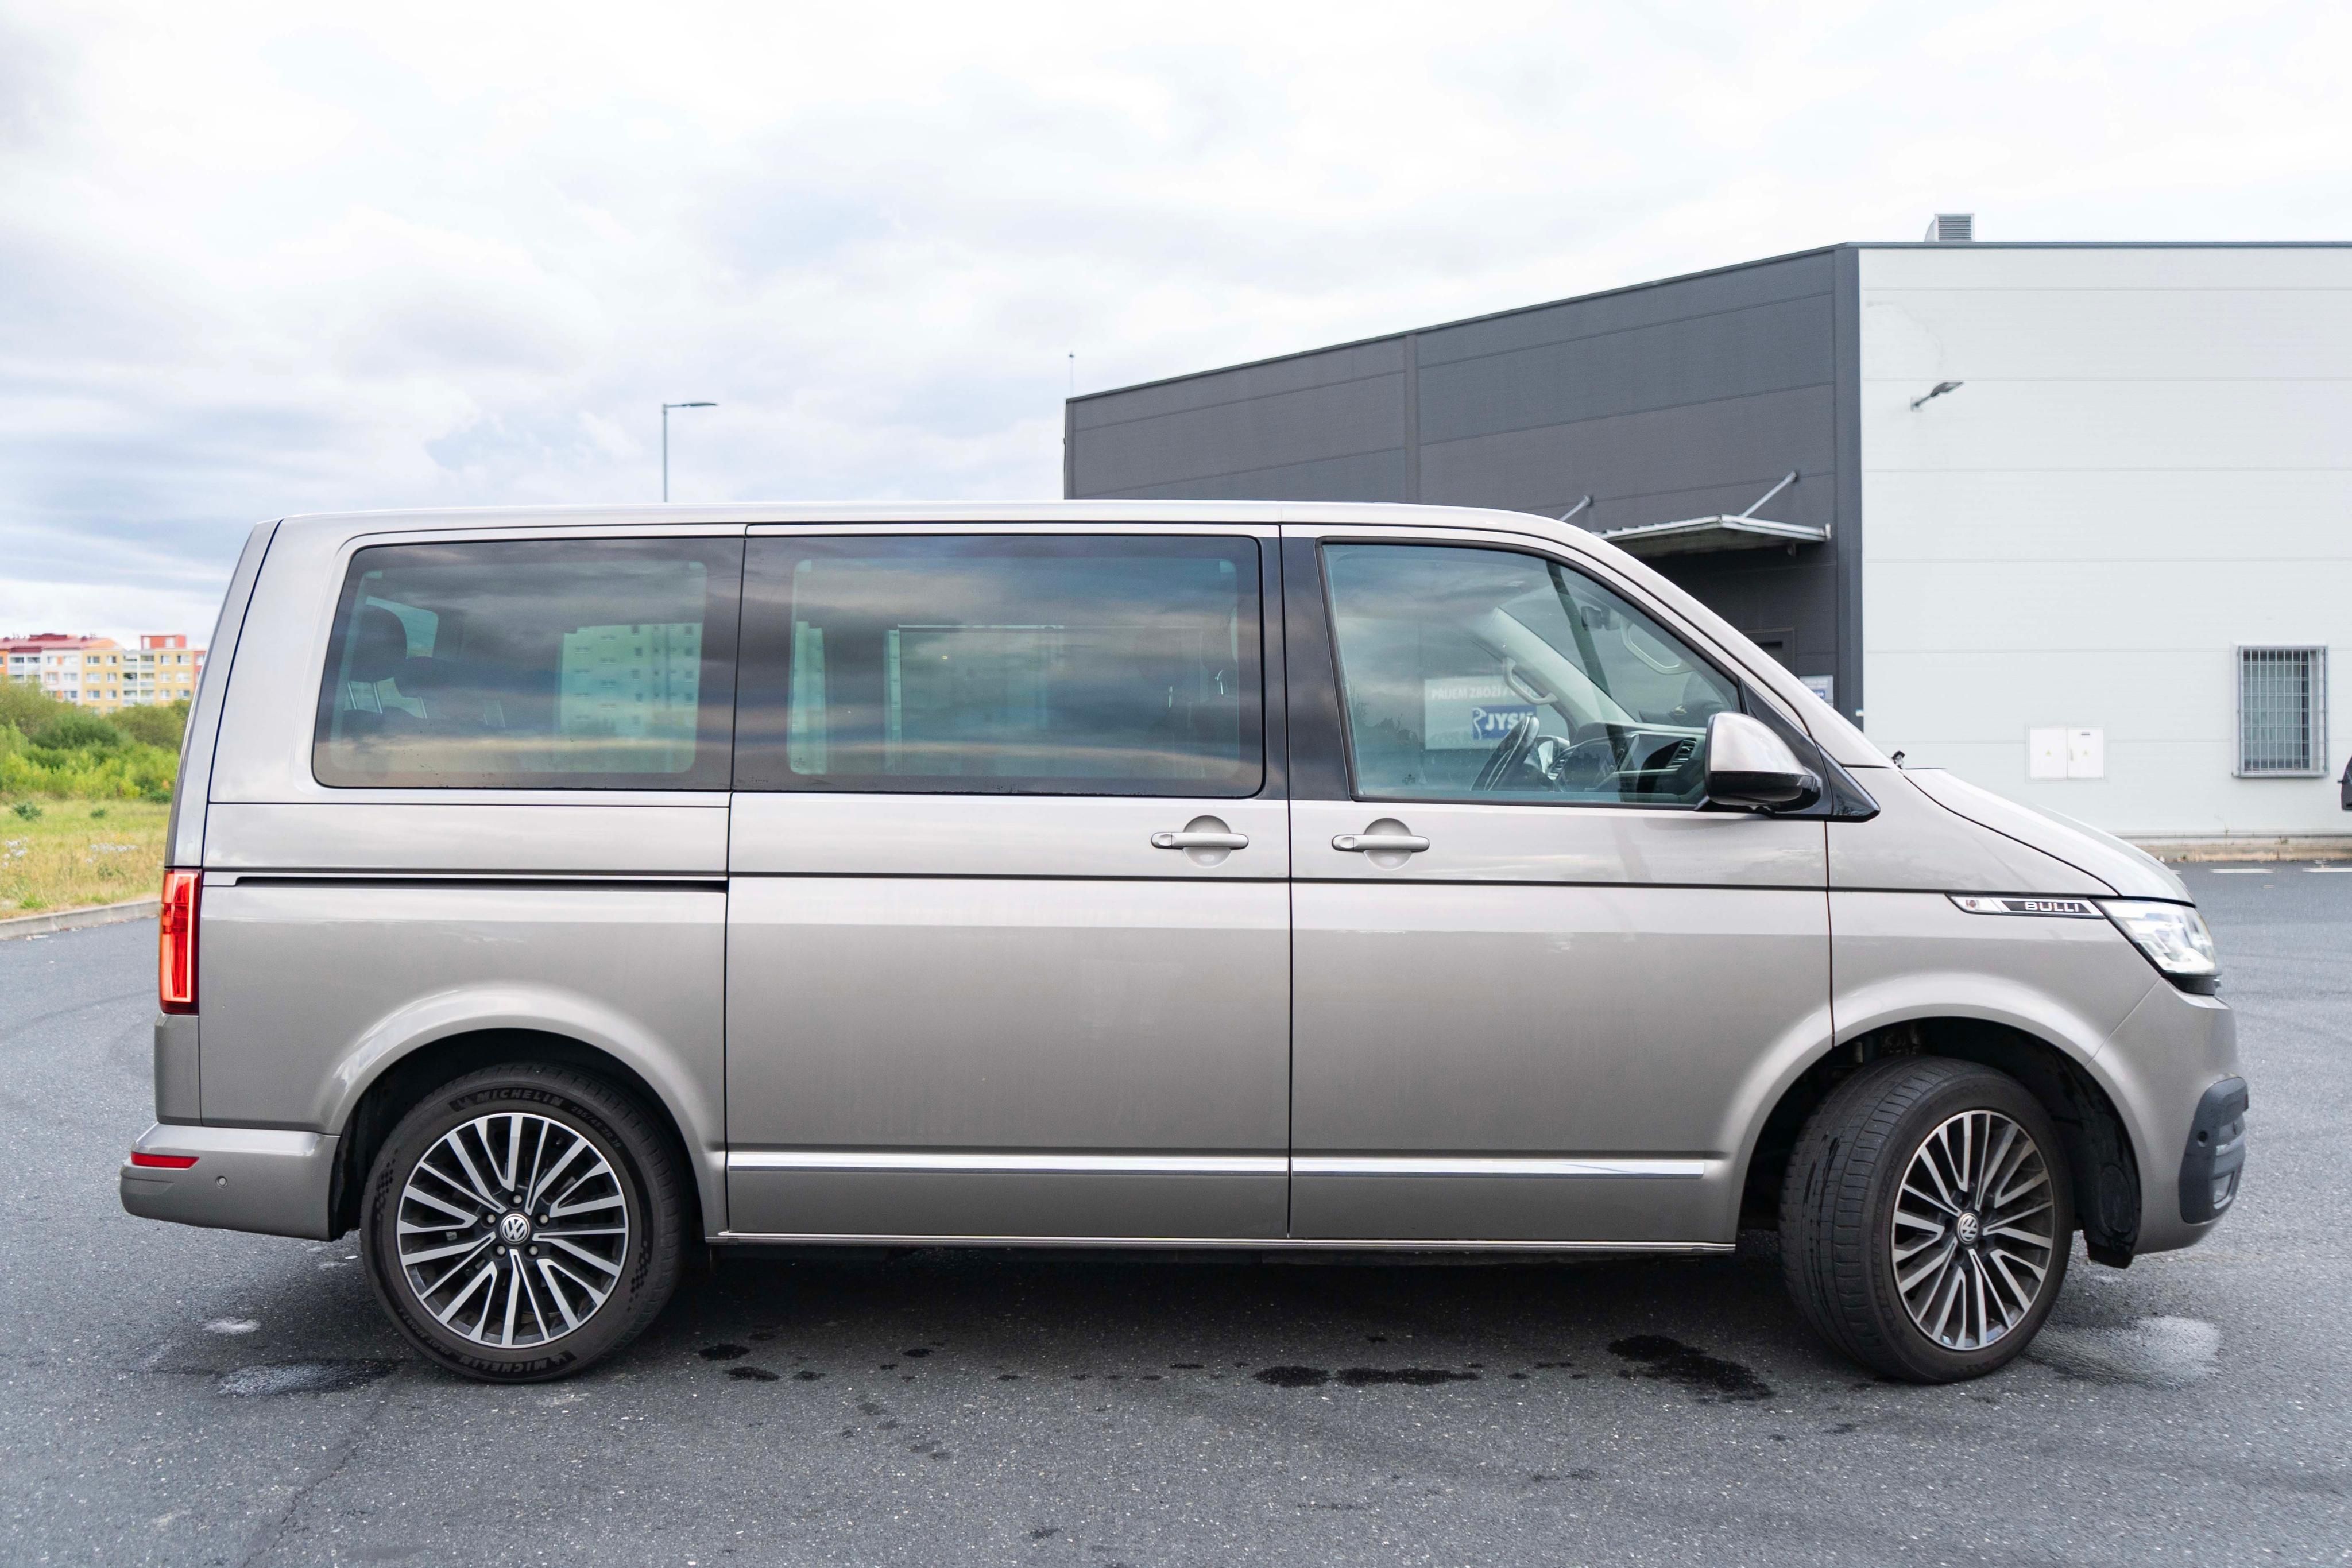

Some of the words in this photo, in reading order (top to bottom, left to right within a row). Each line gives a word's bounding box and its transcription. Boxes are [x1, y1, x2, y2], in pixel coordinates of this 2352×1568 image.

[2024, 901, 2079, 912] BULLI
[476, 1089, 564, 1107] MICHELIN
[459, 1355, 547, 1373] MICHELIN
